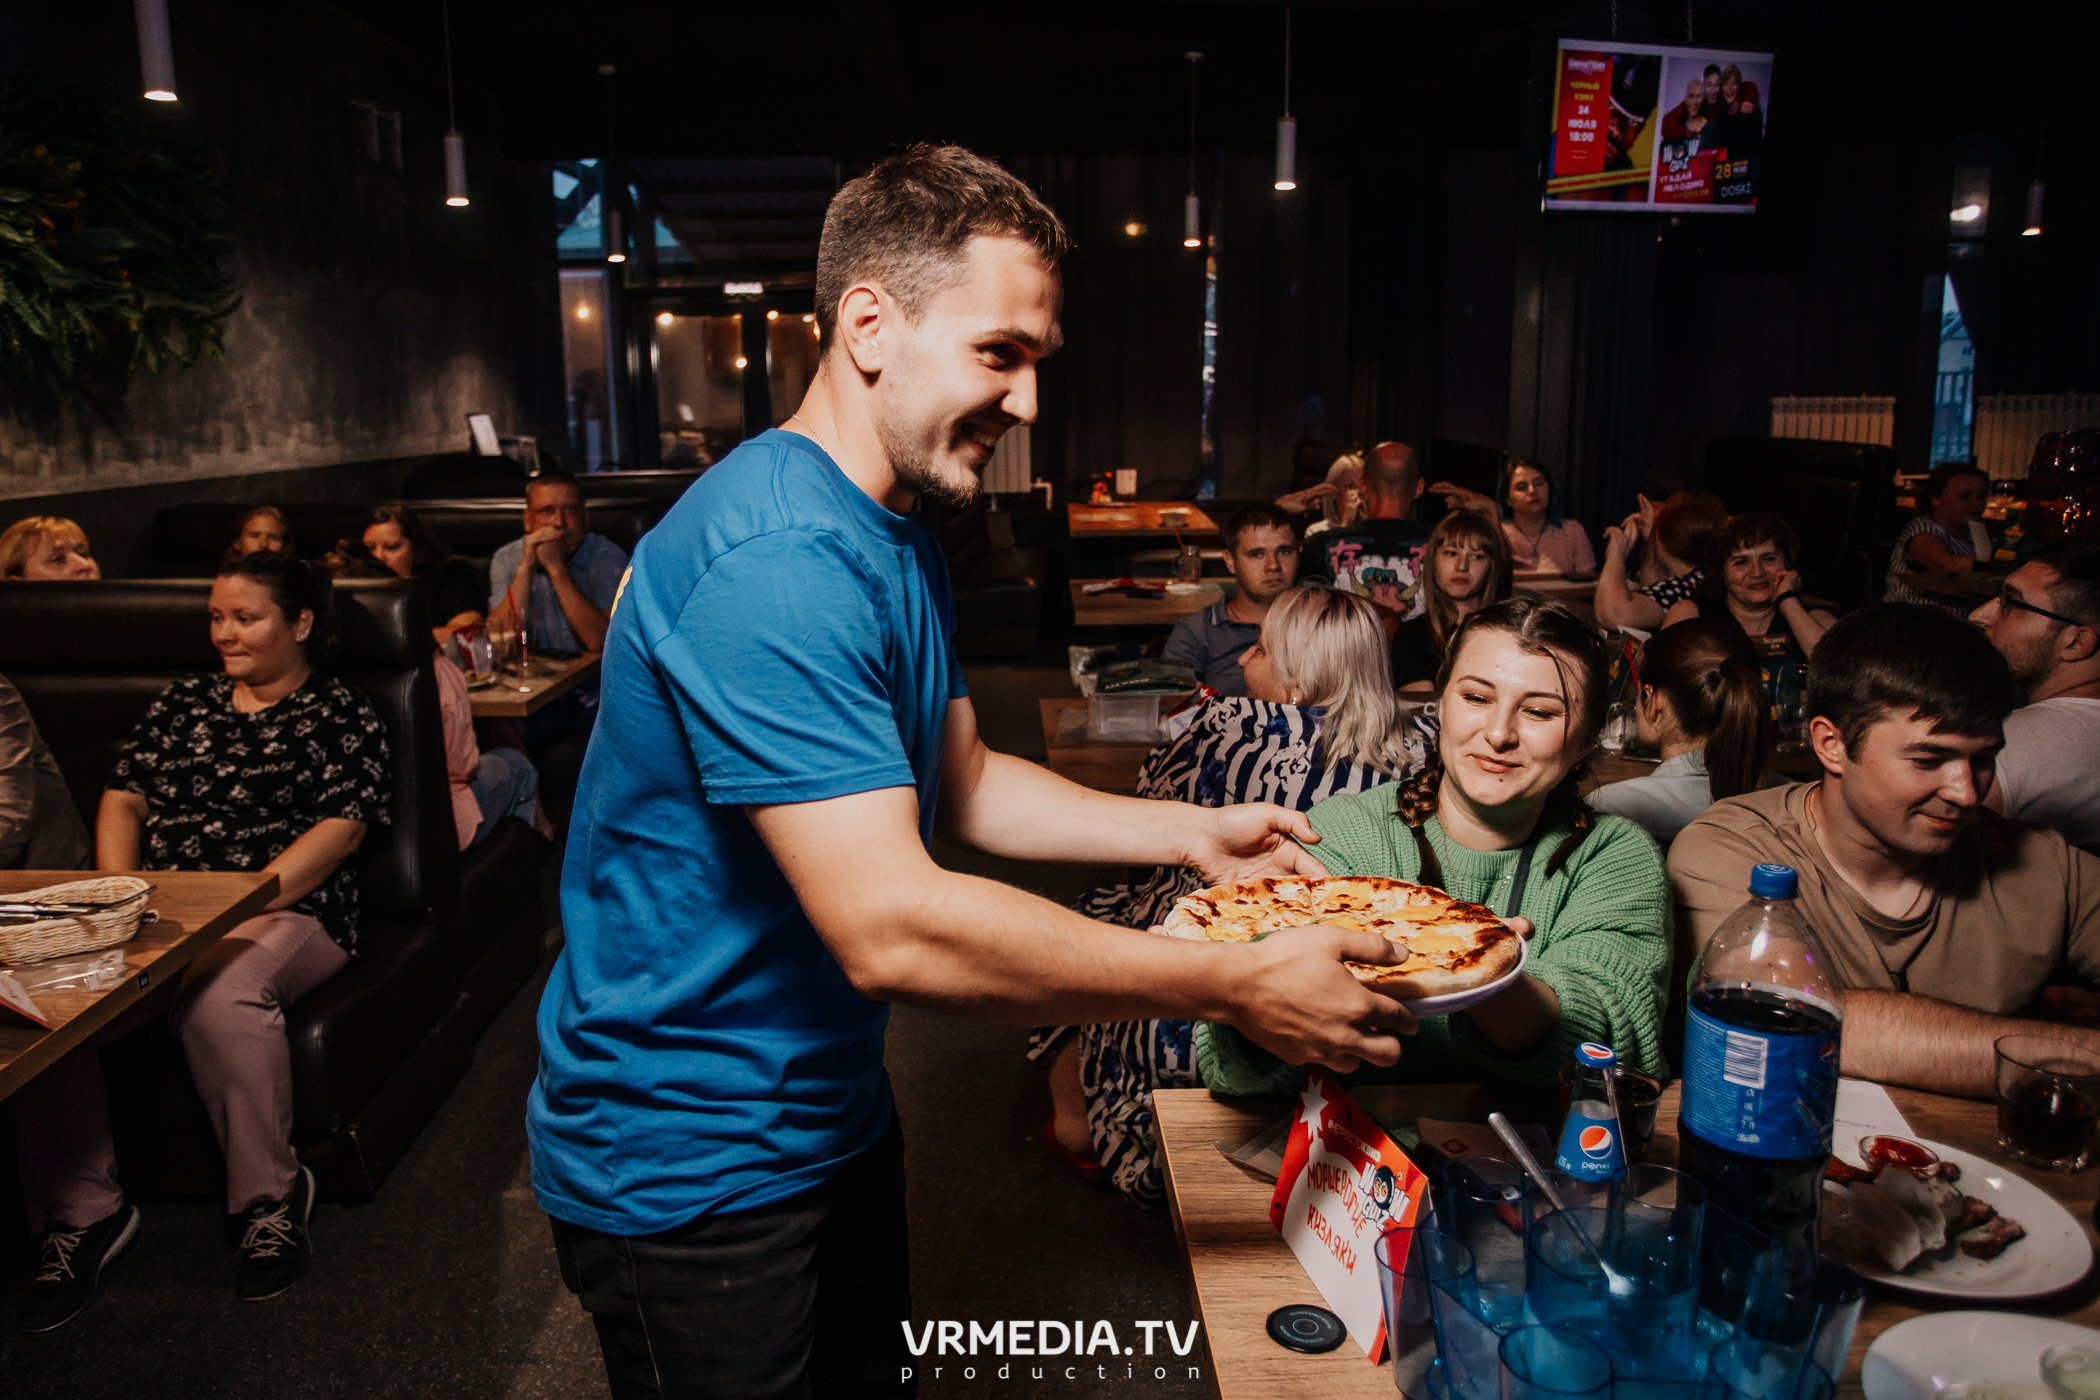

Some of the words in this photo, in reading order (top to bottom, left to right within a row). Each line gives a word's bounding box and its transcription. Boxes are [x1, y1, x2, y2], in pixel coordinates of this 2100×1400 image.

[1714, 162, 1731, 180] 28
[1721, 182, 1751, 198] DOSKI
[1362, 1194, 1389, 1232] QUIZ
